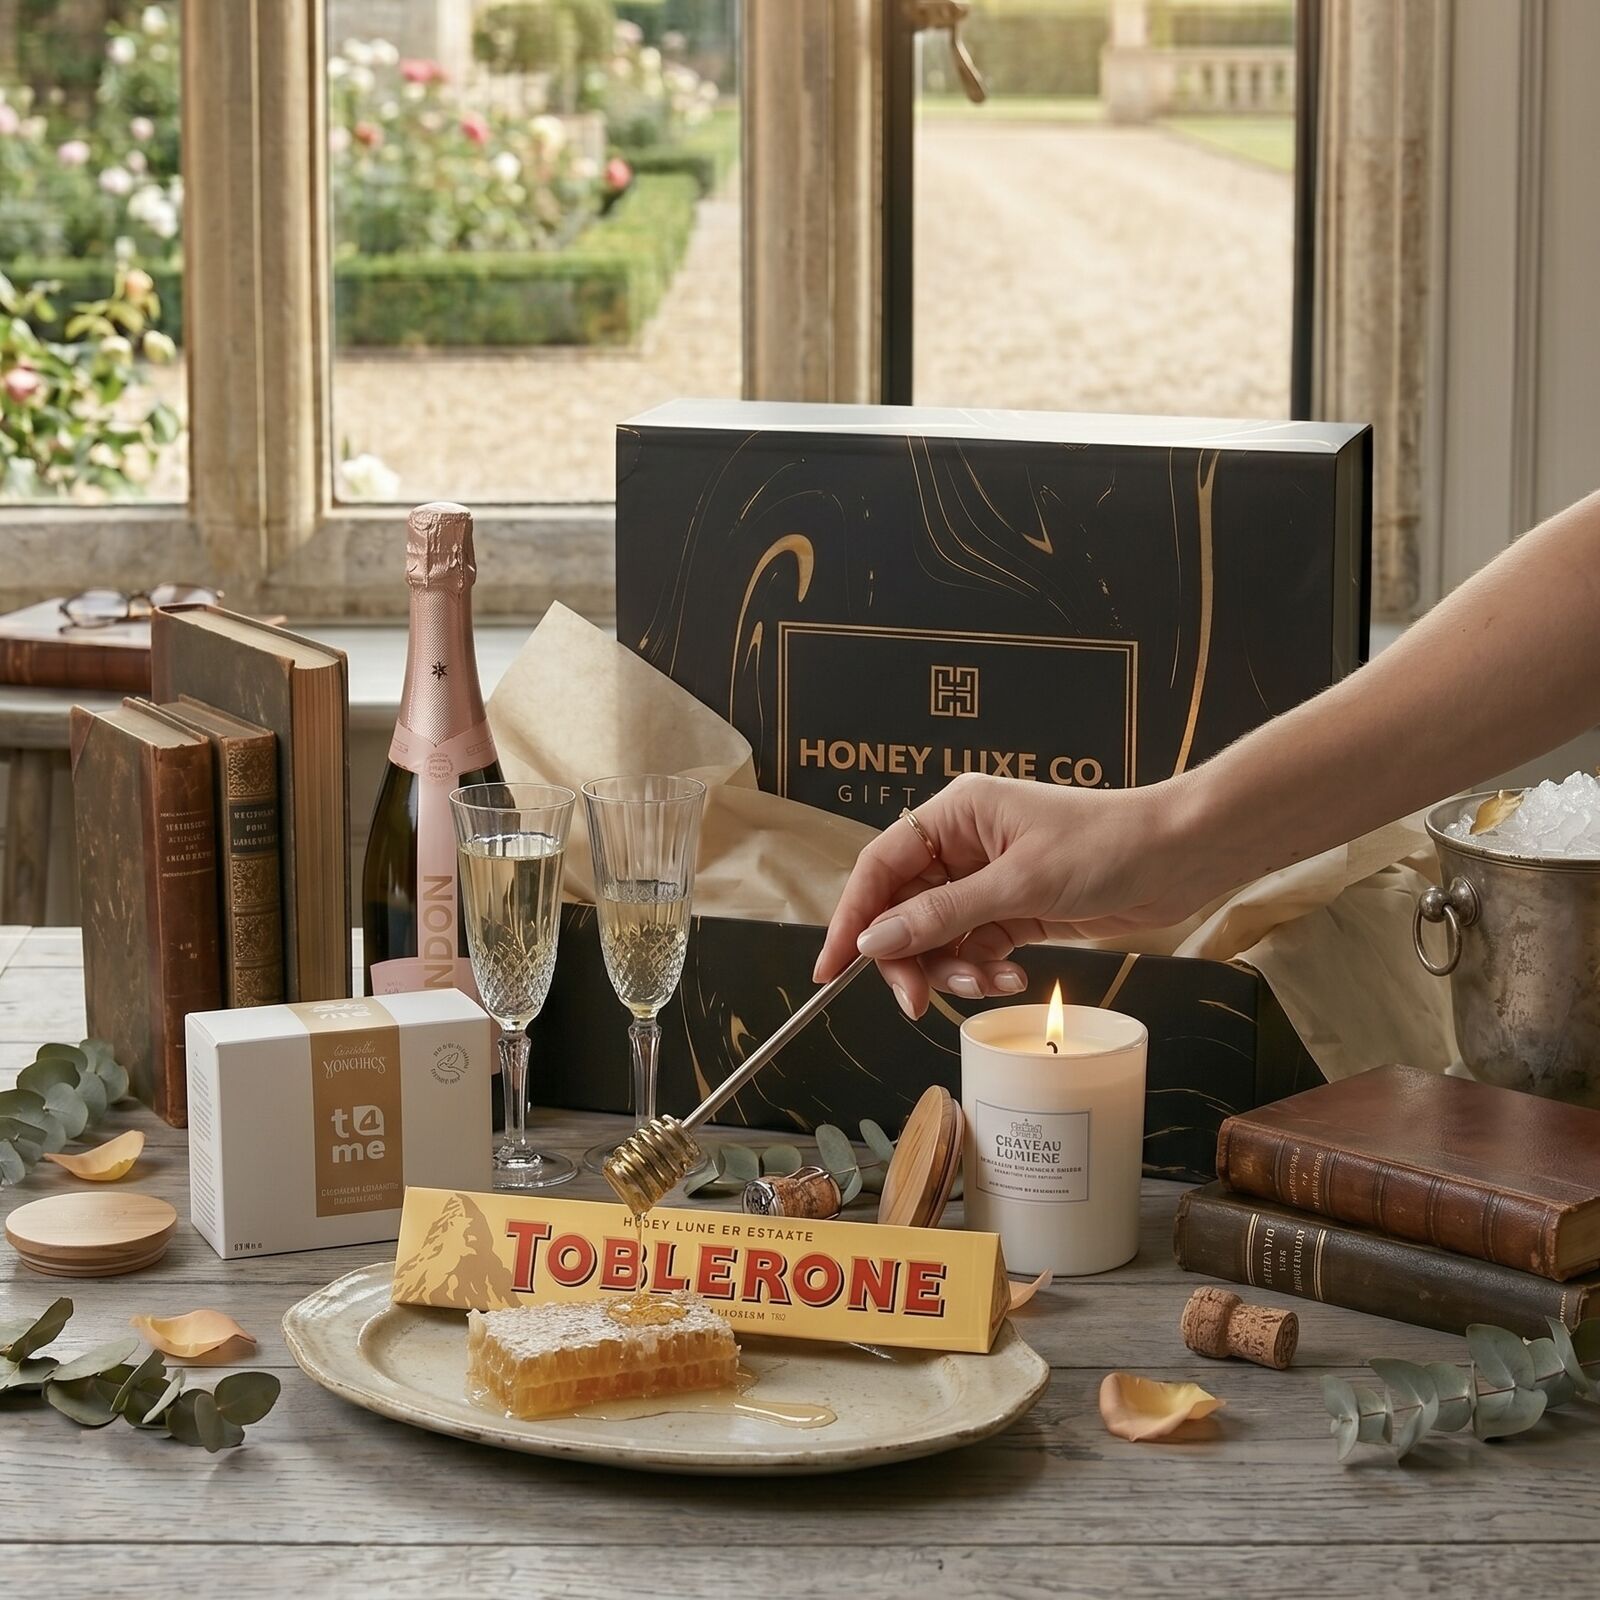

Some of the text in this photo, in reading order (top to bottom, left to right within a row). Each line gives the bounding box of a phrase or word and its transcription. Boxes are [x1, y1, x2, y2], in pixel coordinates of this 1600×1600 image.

[800, 738, 1110, 787] HONEY LUXE CO.
[838, 785, 916, 807] GIFT
[332, 1140, 386, 1163] me
[995, 1134, 1062, 1152] CRAVEAU
[996, 1146, 1061, 1164] LUMIENE
[676, 1221, 716, 1234] LUNE
[721, 1225, 741, 1237] ER
[504, 1218, 947, 1318] TOBLERONE
